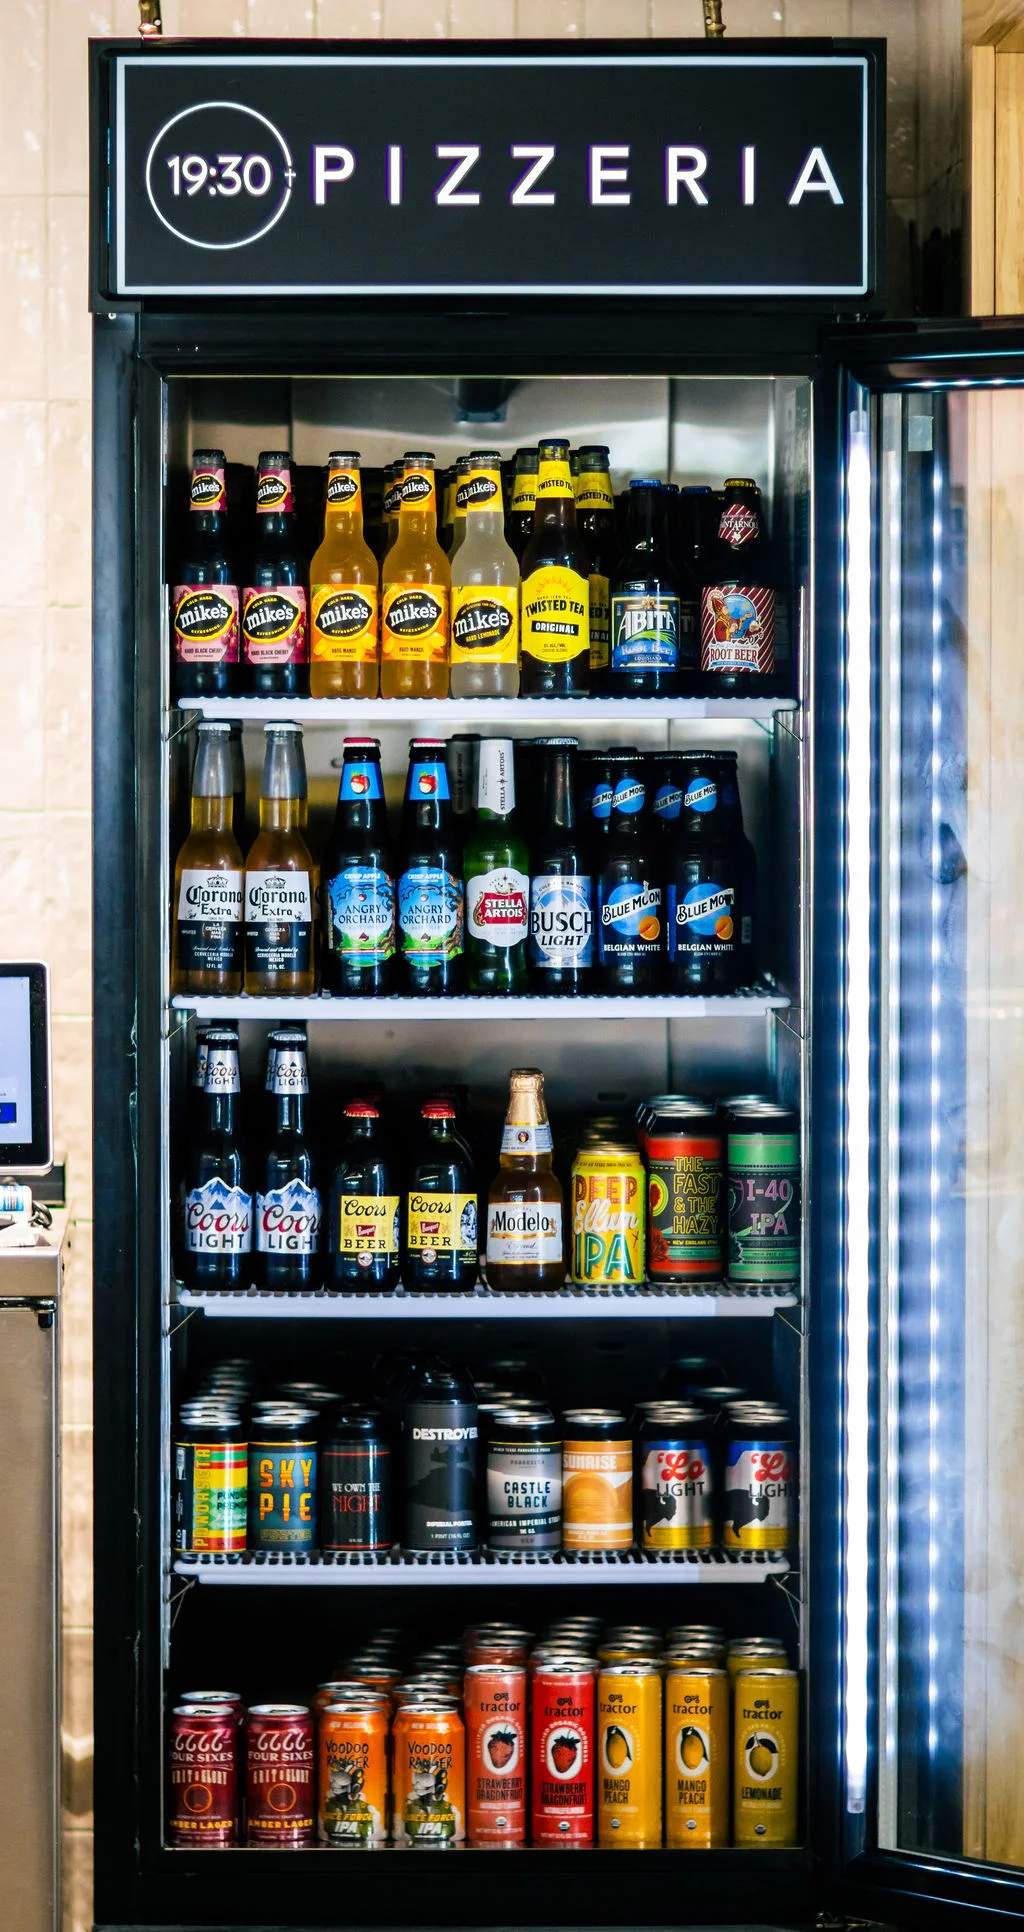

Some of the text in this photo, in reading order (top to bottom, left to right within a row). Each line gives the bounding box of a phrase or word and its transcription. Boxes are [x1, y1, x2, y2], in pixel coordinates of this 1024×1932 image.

[167, 145, 844, 205] 19:30 PIZZERIA
[328, 482, 356, 498] mike's
[538, 479, 564, 492] TWISTED
[389, 603, 437, 628] mike's
[525, 599, 567, 618] TWISTED
[569, 600, 585, 617] TEA
[180, 603, 228, 629] mike's
[246, 605, 294, 631] mike's
[320, 603, 368, 629] mike's
[455, 609, 510, 638] mike's
[535, 622, 575, 634] ORIGINAL
[616, 610, 677, 647] ABITA
[710, 648, 733, 661] ROOT
[735, 648, 758, 664] BEER
[613, 793, 629, 807] BLUE
[685, 792, 702, 806] BLUE
[186, 885, 242, 908] Corona
[249, 886, 305, 909] Corona
[484, 898, 523, 909] STELLA
[201, 903, 232, 916] Extra
[262, 904, 293, 917] Extra
[346, 904, 381, 915] ANGRY
[408, 904, 445, 915] ANGRY
[484, 908, 523, 919] ARTOIS
[602, 890, 661, 924] BLUE MOON
[677, 903, 707, 924] BLUE
[338, 913, 388, 925] ORCHARD
[401, 914, 452, 925] ORCHARD
[531, 911, 593, 934] BUSCH
[541, 935, 584, 946] LIGHT
[604, 944, 635, 952] BELGIAN
[207, 1062, 238, 1078] Coors
[207, 1077, 235, 1085] LIGHT
[673, 1156, 704, 1173] THE
[575, 1174, 638, 1206] DEEP
[673, 1173, 721, 1195] FAST
[746, 1179, 791, 1202] I-40
[344, 1199, 387, 1217] Coors
[411, 1195, 453, 1214] Coors
[673, 1196, 717, 1213] & THE
[187, 1202, 250, 1233] Coors
[495, 1211, 549, 1231] Modelo
[750, 1213, 788, 1236] IPA
[673, 1215, 719, 1235] HAZY
[190, 1233, 245, 1249] LIGHT
[344, 1239, 386, 1249] BEER
[410, 1236, 452, 1246] BEER
[575, 1232, 636, 1280] IPA
[564, 1454, 617, 1470] SUNRISE
[260, 1458, 313, 1488] SKY
[332, 1482, 381, 1493] WE OWN THE
[504, 1481, 551, 1494] CASTLE
[657, 1482, 705, 1498] LIGHT
[749, 1484, 787, 1498] LIGH
[194, 1449, 210, 1547] PONDASETA
[333, 1494, 380, 1513] NIGHT
[507, 1496, 549, 1508] BLACK
[259, 1492, 312, 1522] PIE
[480, 1702, 521, 1713] tractor
[544, 1707, 585, 1717] tractor
[600, 1702, 637, 1714] tractor
[673, 1704, 714, 1715] tractor
[743, 1708, 784, 1720] tractor
[325, 1740, 370, 1754] VOODOO
[408, 1741, 453, 1755] VOODOO
[170, 1751, 234, 1762] FOUR SIXES
[248, 1750, 313, 1762] FOUR SIXES
[327, 1755, 370, 1770] RANGER
[409, 1756, 453, 1770] RANGER
[477, 1777, 523, 1791] STRAWBERRY
[542, 1782, 587, 1795] STRAWBERRY
[603, 1779, 630, 1791] MANGO
[678, 1779, 707, 1792] MANGO
[476, 1789, 523, 1801] DRAGONFRUIT
[541, 1794, 588, 1806] DRAGONFRUIT
[604, 1791, 629, 1804] PEACH
[679, 1792, 705, 1805] PEACH
[741, 1786, 783, 1801] LEMONADE
[249, 1819, 313, 1829] AMBER LAGER
[343, 1813, 373, 1821] FORCE
[428, 1813, 456, 1822] FORCE
[199, 1820, 233, 1829] LAGER
[334, 1821, 359, 1834] IPA
[417, 1822, 443, 1835] IPA
